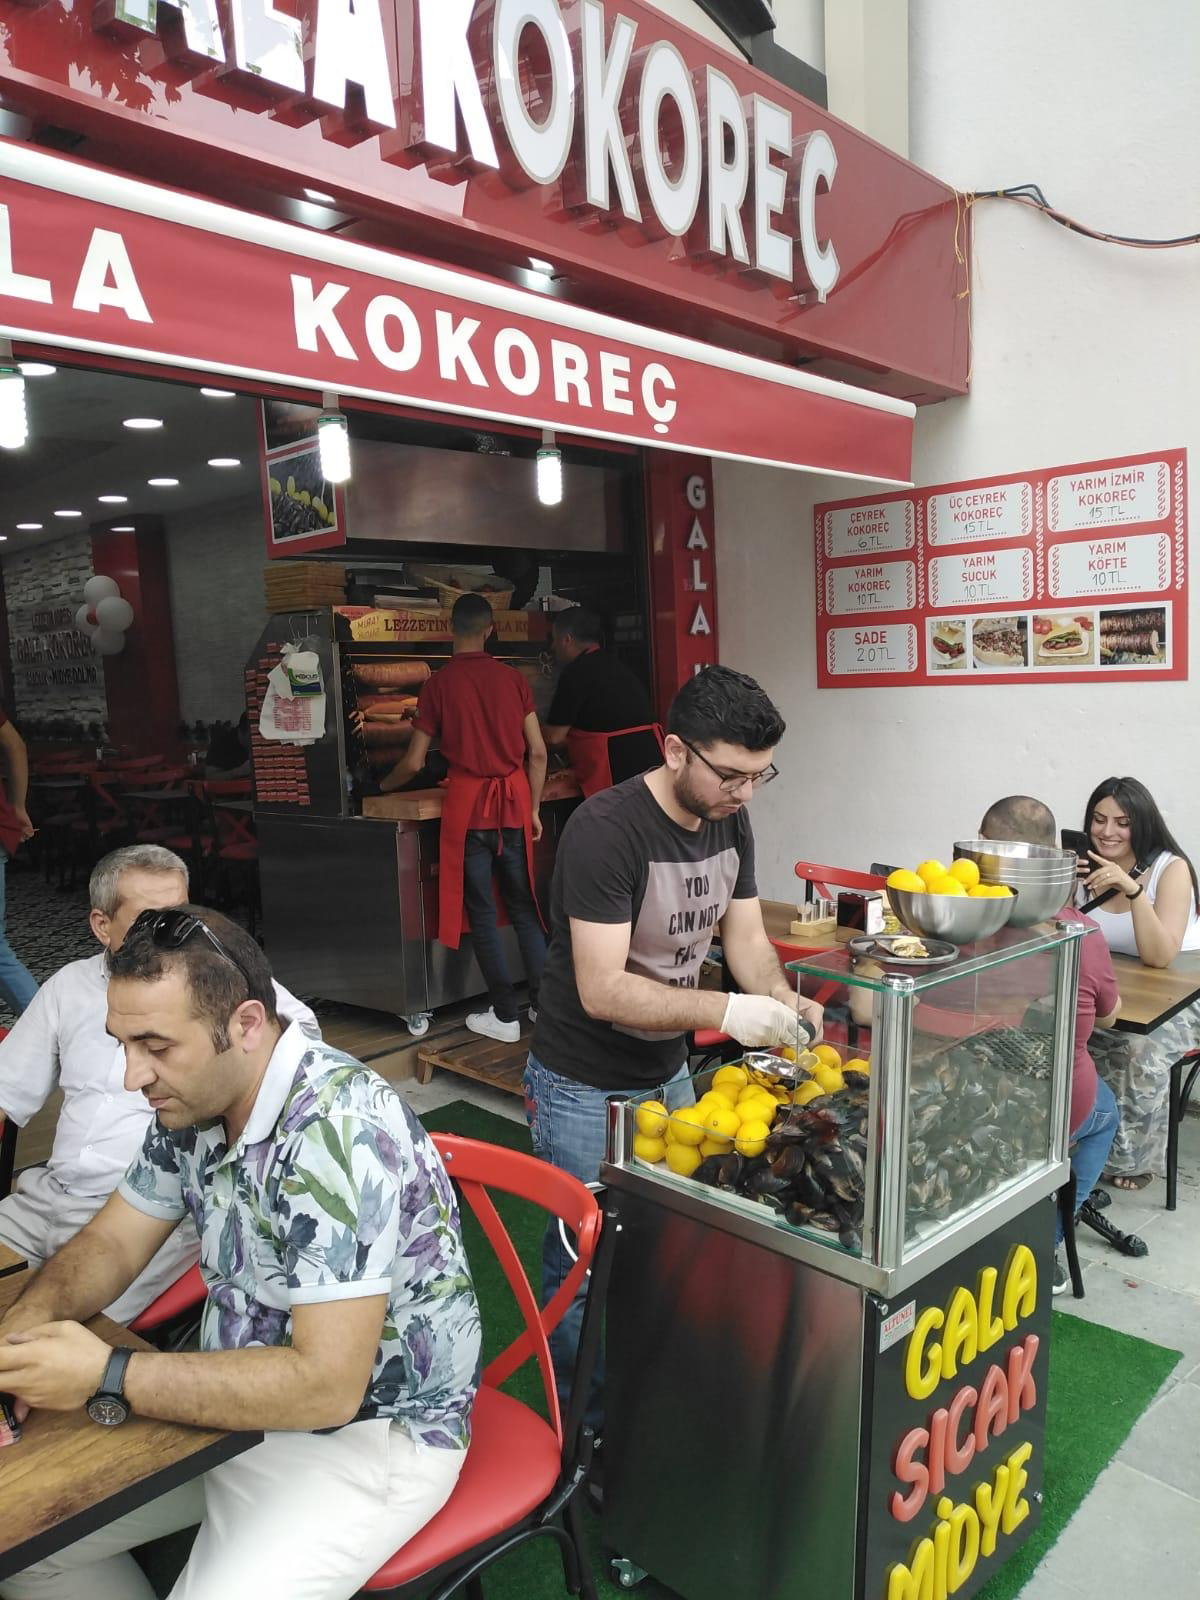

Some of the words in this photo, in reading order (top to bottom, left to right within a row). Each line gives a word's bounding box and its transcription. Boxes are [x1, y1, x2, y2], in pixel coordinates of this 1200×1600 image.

[290, 274, 678, 434] KOKOREÇ
[1070, 475, 1108, 492] YARIM
[1110, 470, 1145, 487] İZMİR
[950, 495, 963, 509] ÜÇ
[965, 490, 1007, 508] ÇEYREK
[1079, 489, 1137, 507] KOKOREÇ
[850, 509, 886, 523] ÇEYREK
[953, 506, 1004, 522] KOKOREÇ
[847, 522, 890, 536] KOKOREÇ
[1088, 542, 1127, 555] YARIM
[962, 555, 996, 568] YARIM
[1088, 555, 1128, 571] KÖFTE
[854, 567, 883, 579] YARIM
[961, 570, 997, 582] SUCUK
[848, 580, 891, 593] KOKOREÇ
[854, 630, 888, 645] SADE
[685, 874, 710, 898] YOU
[668, 911, 696, 936] CAN
[698, 904, 720, 931] NOT
[905, 1244, 1038, 1400] GALA
[891, 1334, 1040, 1522] SICAK
[888, 1441, 1032, 1600] MİDYE
